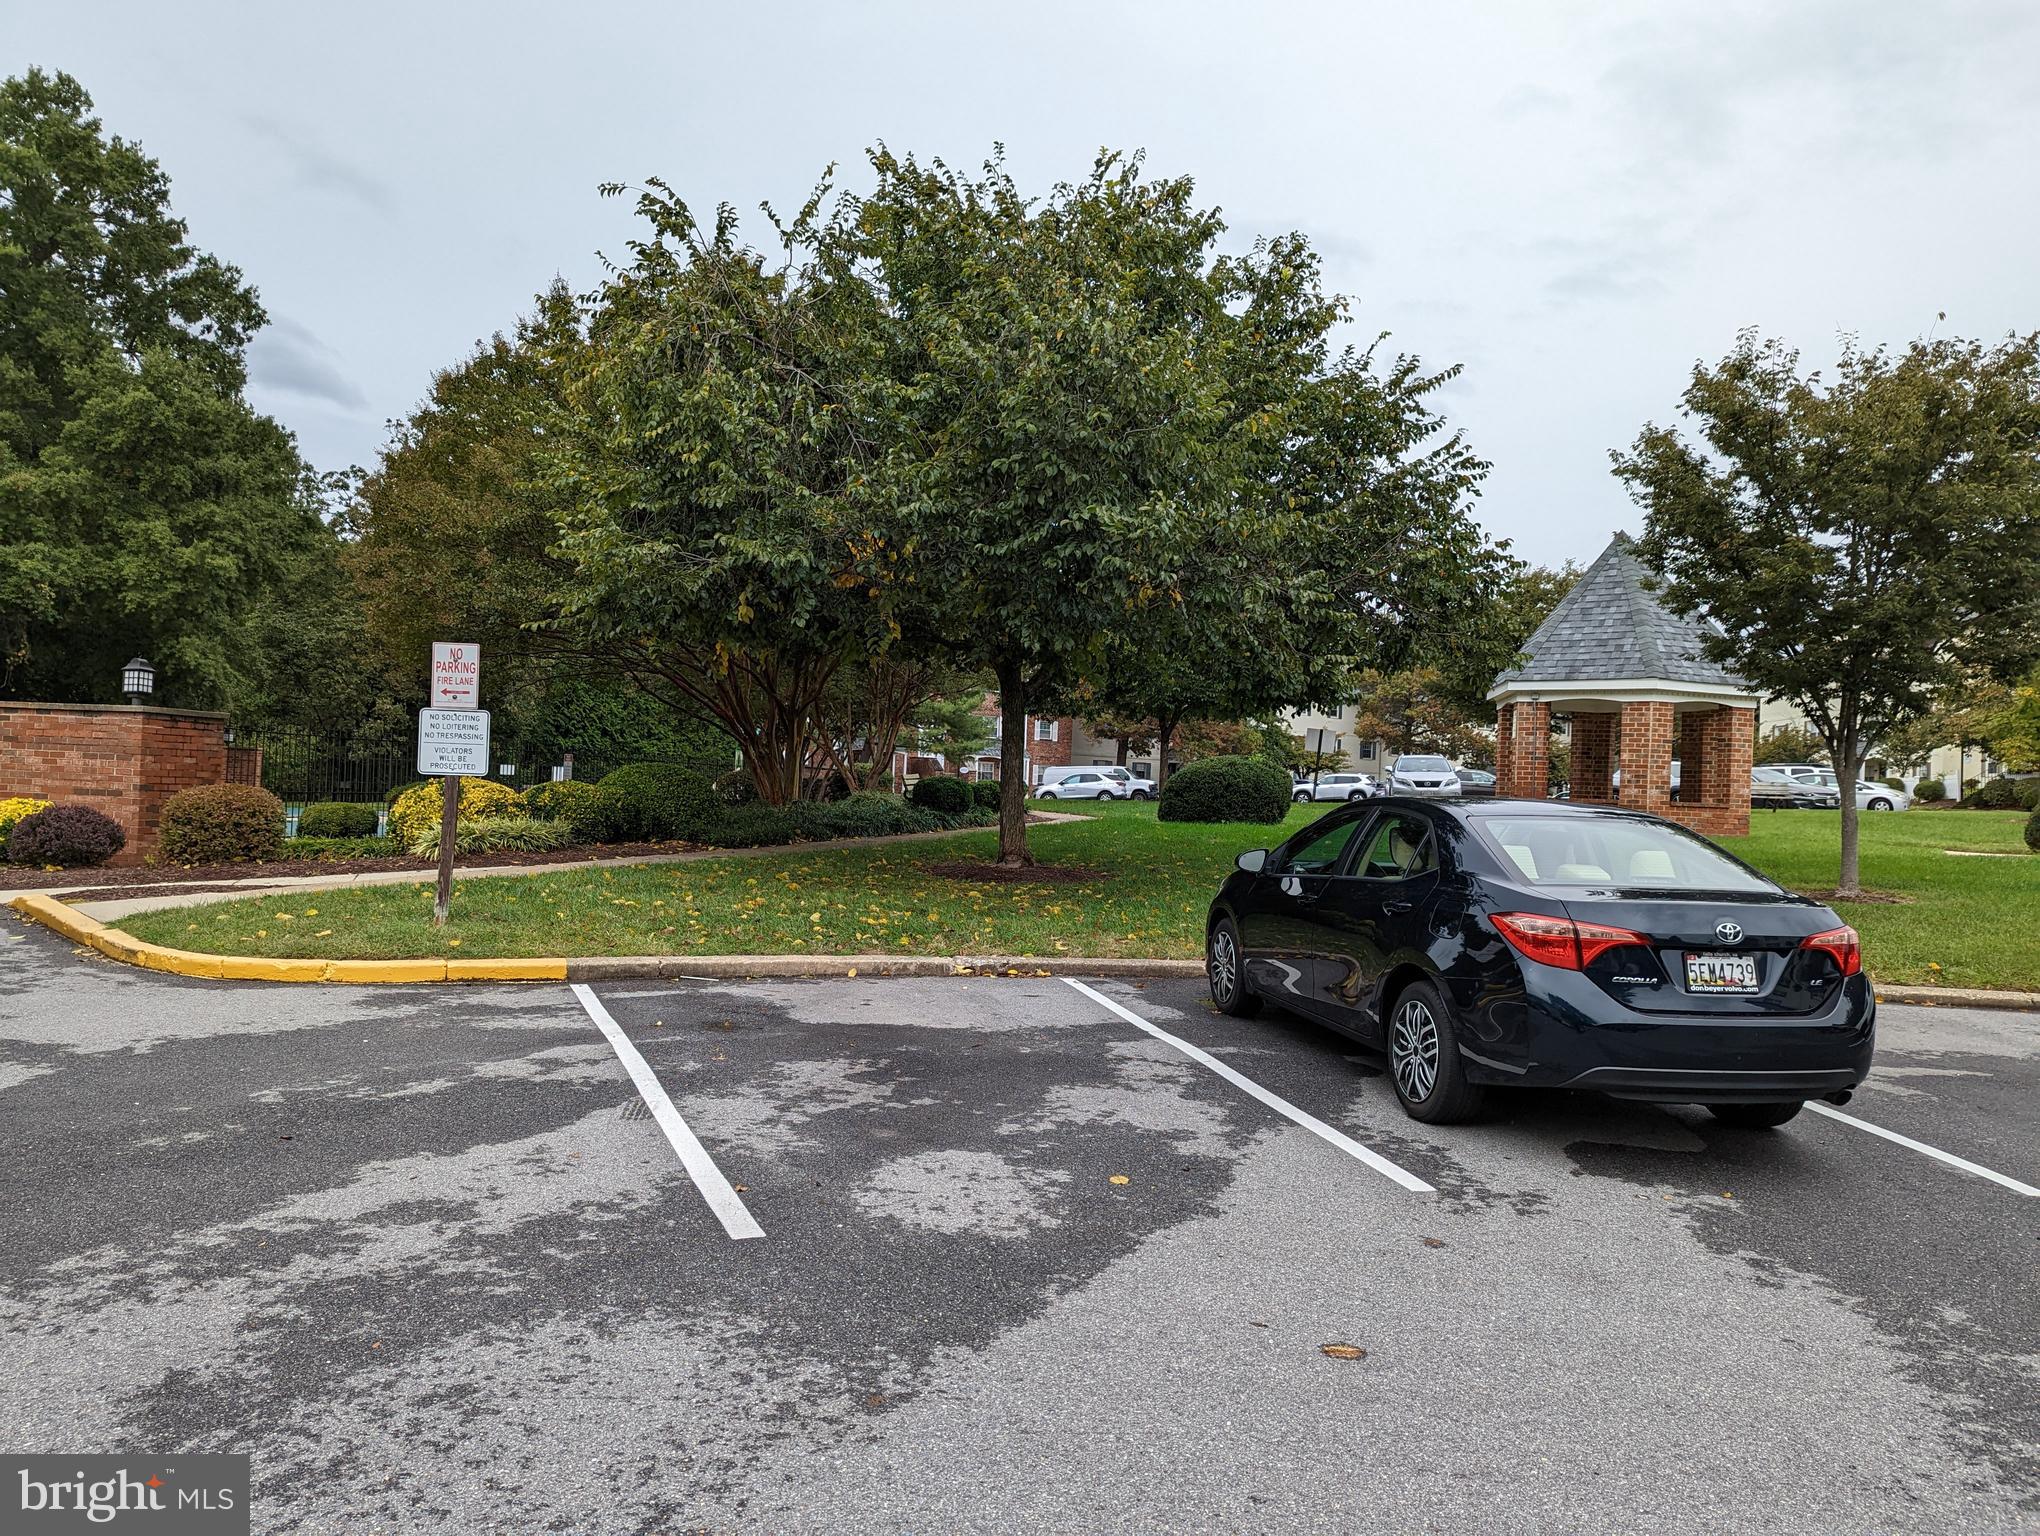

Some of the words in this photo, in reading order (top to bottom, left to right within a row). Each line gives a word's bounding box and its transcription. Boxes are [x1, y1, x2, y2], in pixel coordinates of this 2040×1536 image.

[450, 648, 463, 660] NO
[436, 661, 476, 674] PARKING
[437, 676, 453, 684] FIRE
[455, 677, 474, 685] LANE
[442, 714, 480, 722] SOLICITING
[437, 732, 484, 740] TRESPASSING
[1689, 963, 1754, 983] 5EM4739
